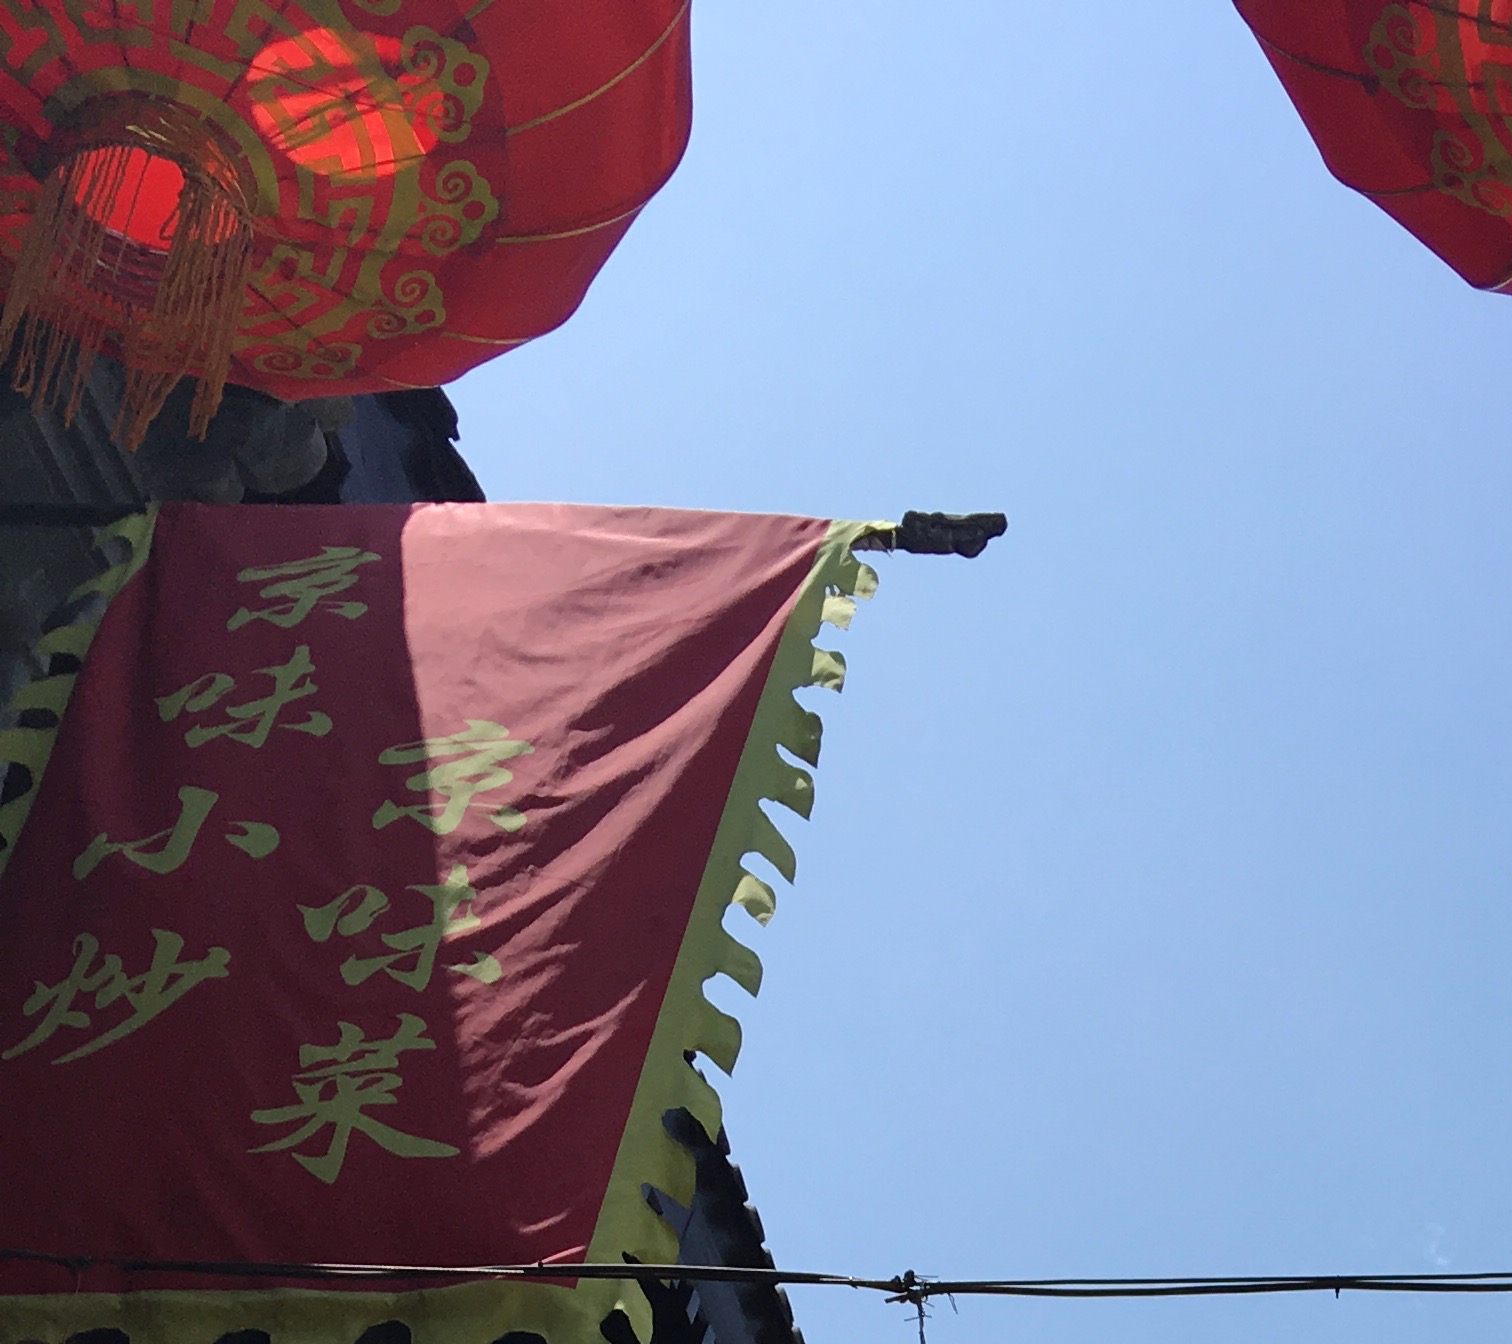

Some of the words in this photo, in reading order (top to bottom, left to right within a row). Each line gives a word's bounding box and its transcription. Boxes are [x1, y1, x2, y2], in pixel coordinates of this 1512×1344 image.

[1, 545, 381, 1065] 京味小炒
[247, 719, 537, 1185] 京味菜
